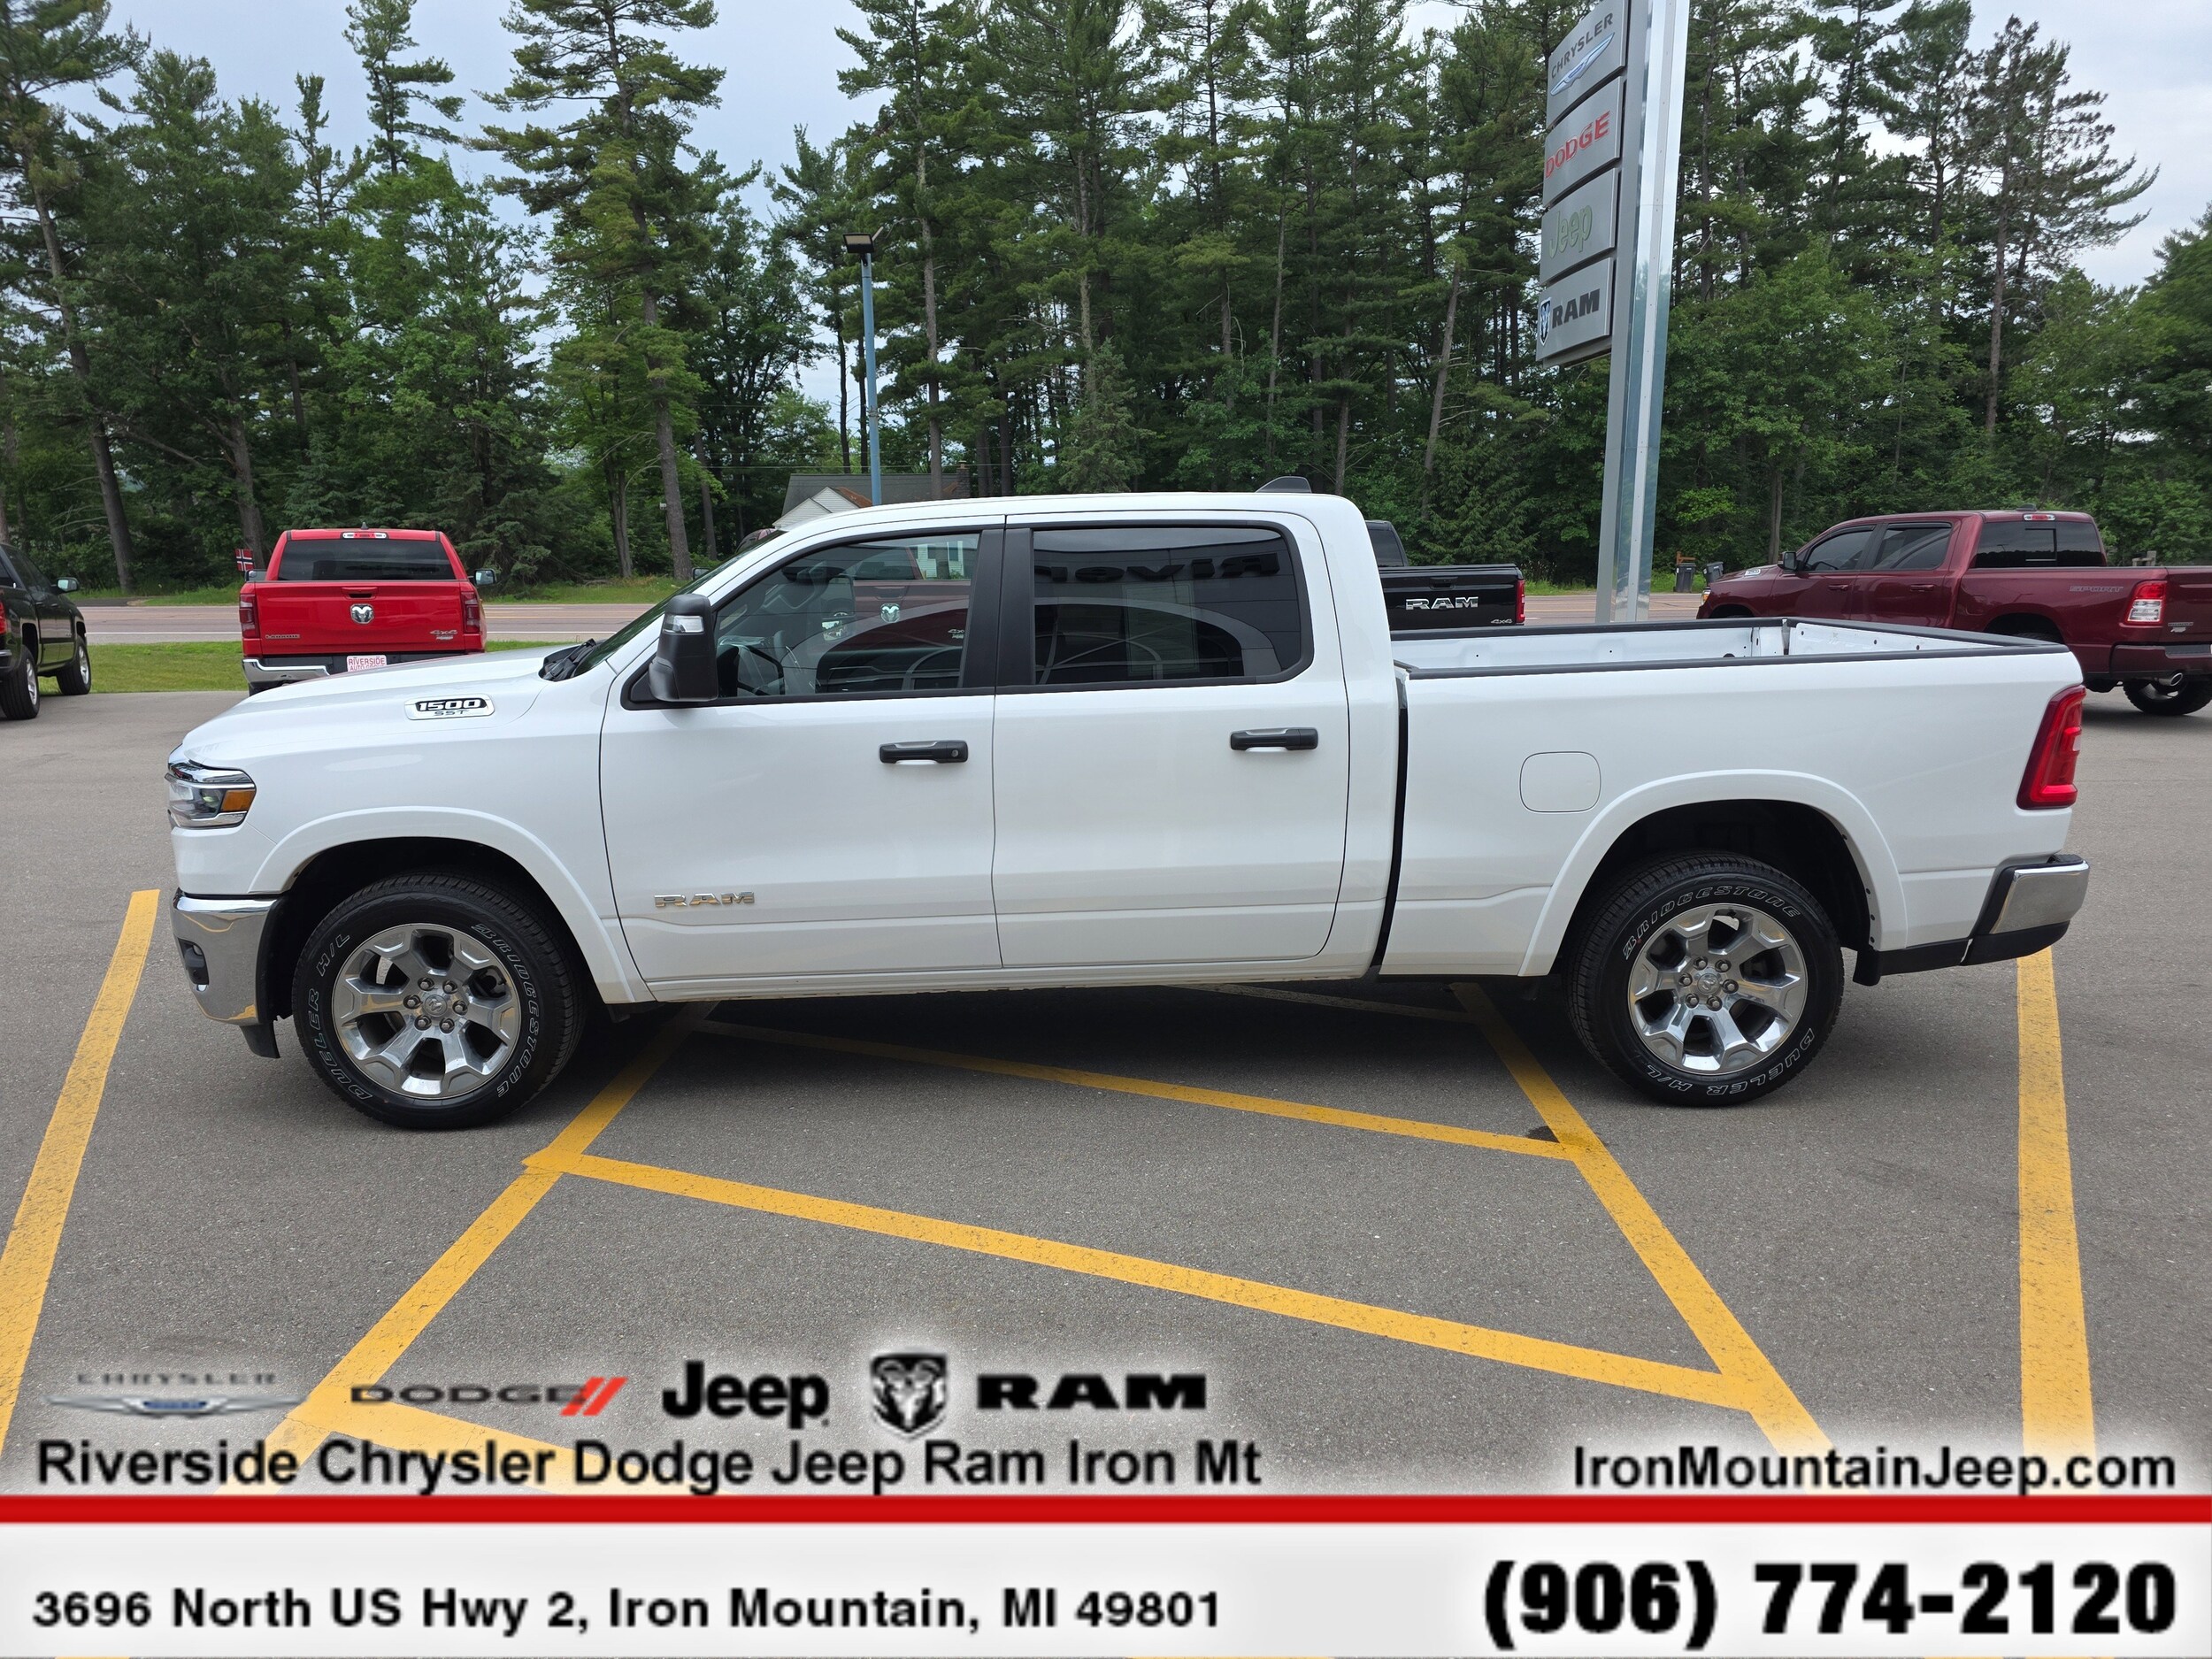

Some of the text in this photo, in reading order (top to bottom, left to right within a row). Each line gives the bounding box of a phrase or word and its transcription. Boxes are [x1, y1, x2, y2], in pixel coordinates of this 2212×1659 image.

[1551, 12, 1615, 80] CHRYSLER
[1545, 111, 1610, 179] DODGE
[1548, 204, 1593, 259] Jeep
[1552, 288, 1600, 329] RAM
[1405, 596, 1479, 611] RAM
[419, 698, 481, 711] 1500
[655, 891, 755, 908] RAM
[1622, 885, 1801, 960] BRIDGESTONE
[308, 988, 373, 1100] DUELER
[471, 923, 540, 1098] BRIDGESTONE
[1706, 1027, 1816, 1096] DUELER
